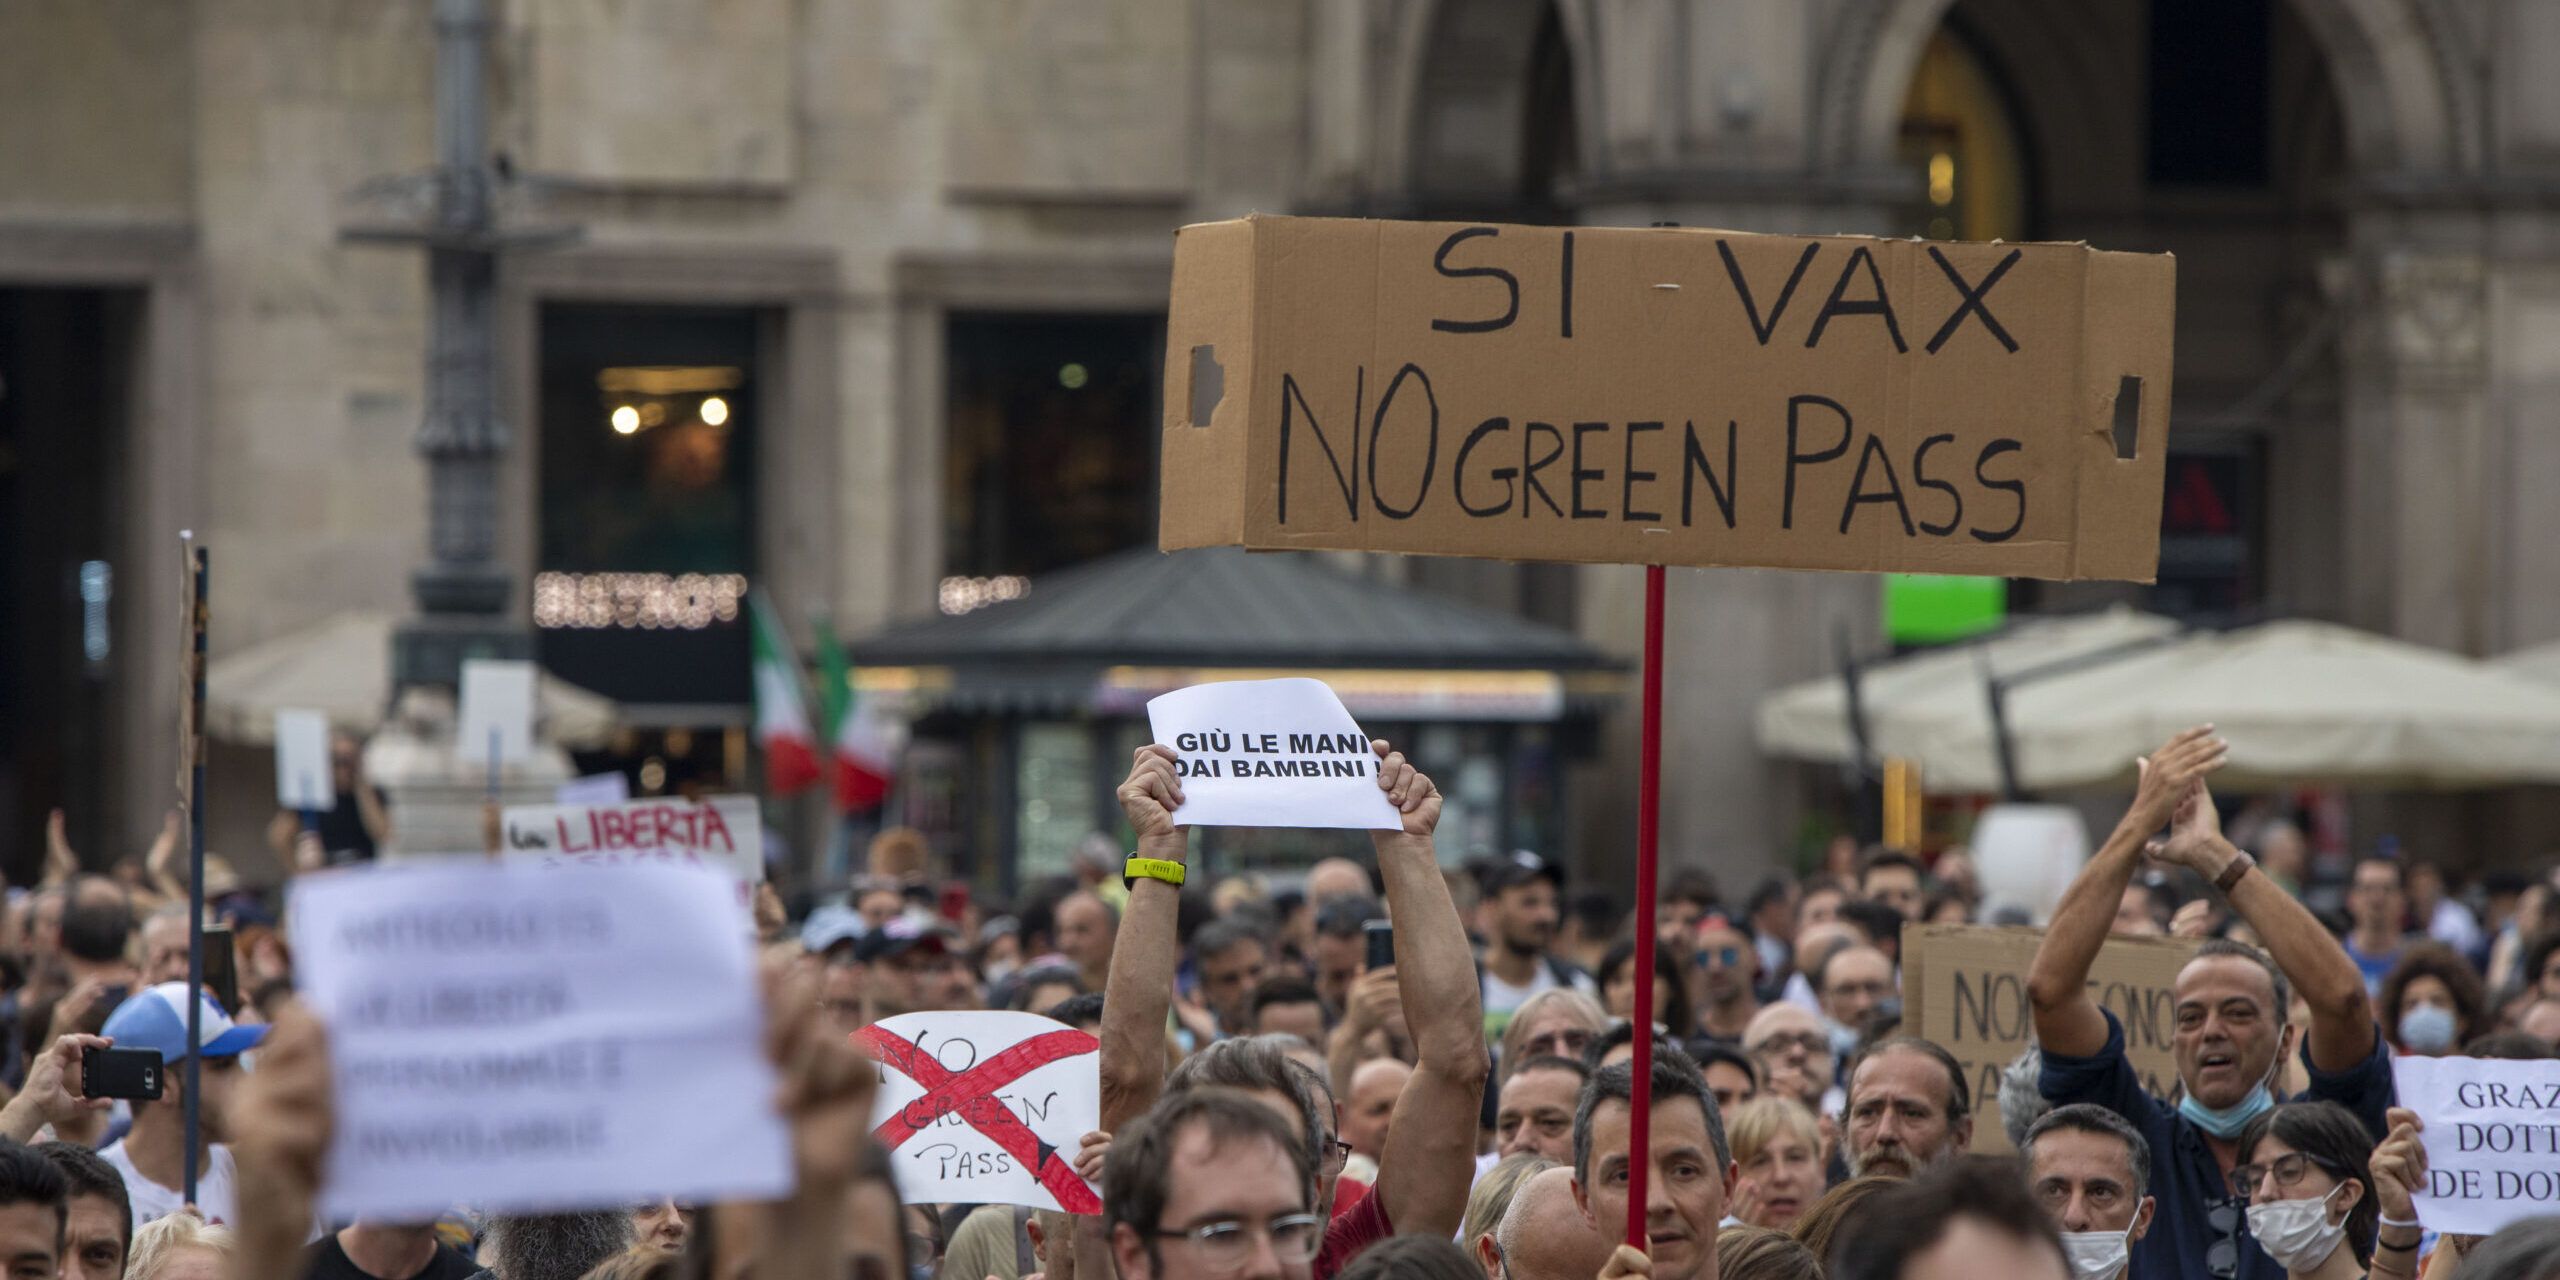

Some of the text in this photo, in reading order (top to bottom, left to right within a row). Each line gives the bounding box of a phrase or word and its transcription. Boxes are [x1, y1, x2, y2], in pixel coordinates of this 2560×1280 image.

[1430, 226, 2022, 355] SI VAX
[1277, 362, 1440, 525] NO
[1453, 415, 1738, 530] GREEN
[1780, 394, 2028, 544] PASS
[1175, 727, 1370, 755] GIÙ LE MANI
[1174, 758, 1222, 778] DAI
[1231, 759, 1366, 778] BAMBINI
[2085, 978, 2176, 1052] ONO
[879, 1029, 976, 1084] NO
[902, 1091, 1057, 1130] GREEN
[2430, 1169, 2560, 1201] DE DO
